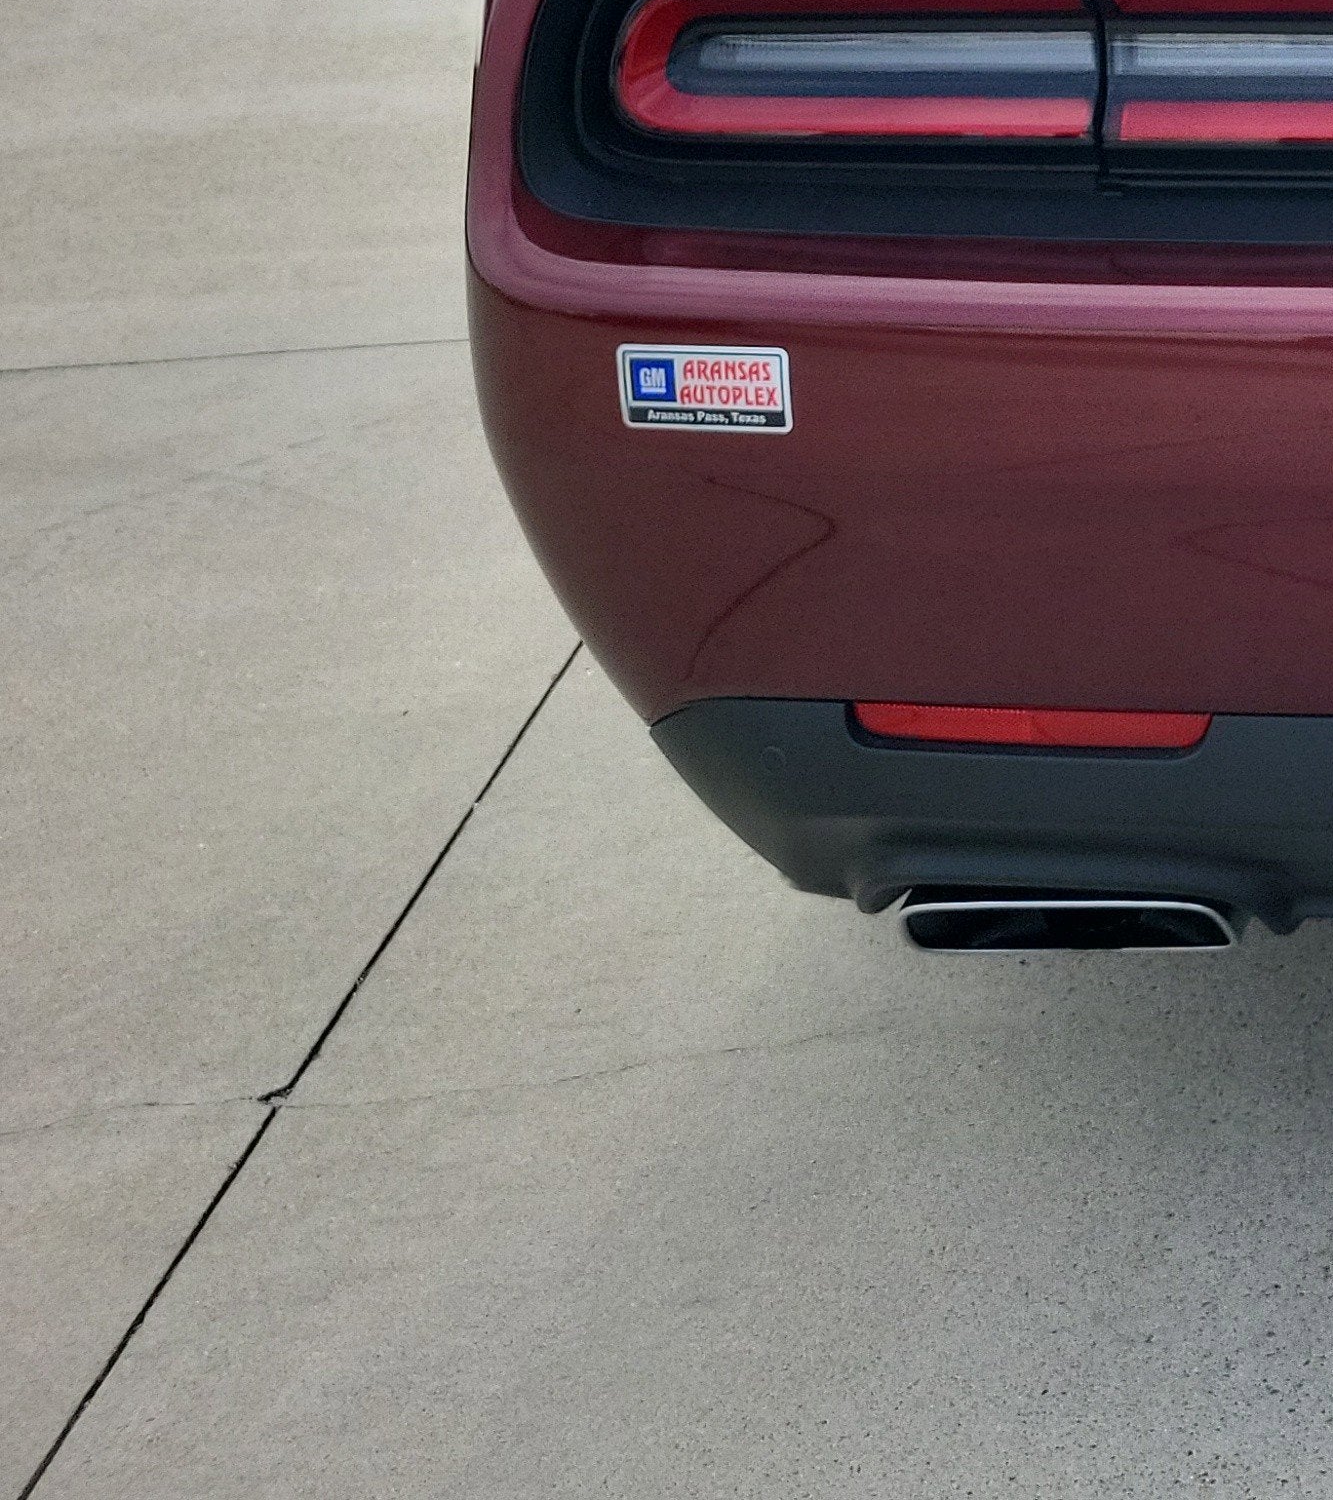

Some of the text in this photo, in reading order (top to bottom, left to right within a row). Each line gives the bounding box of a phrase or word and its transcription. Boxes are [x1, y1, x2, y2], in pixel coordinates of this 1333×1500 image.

[640, 367, 667, 389] GM
[682, 359, 772, 382] ARANSAS
[678, 385, 779, 407] AUTOPLEX
[647, 409, 767, 425] Aransas Pass, Texas
